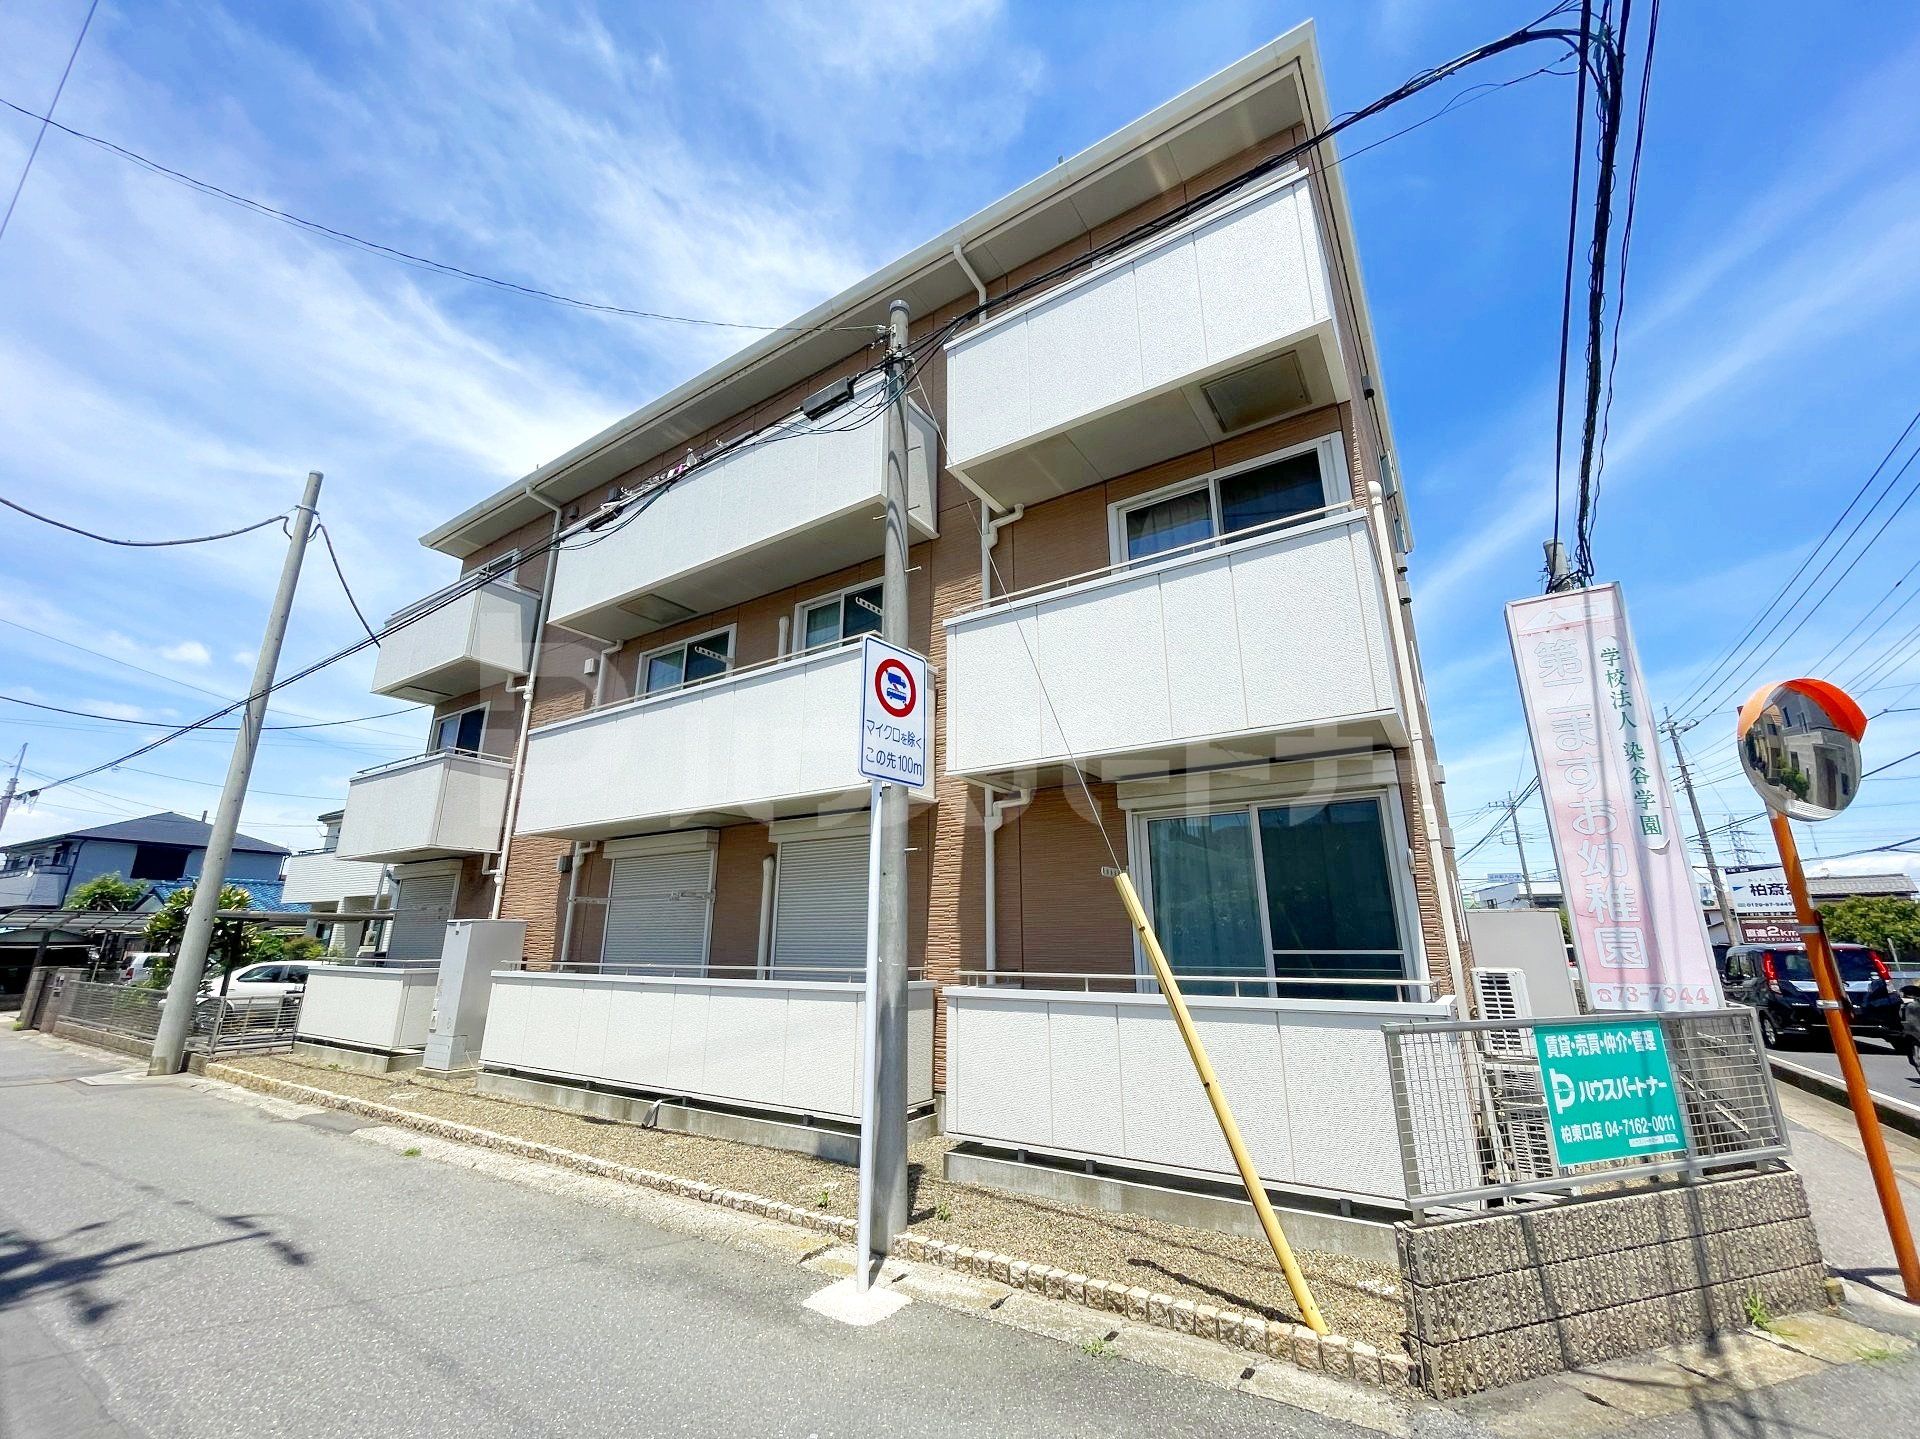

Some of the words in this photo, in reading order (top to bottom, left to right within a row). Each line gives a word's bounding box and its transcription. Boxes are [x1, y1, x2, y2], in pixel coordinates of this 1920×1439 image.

[865, 719, 922, 750] マイクロを除く
[1599, 646, 1638, 731] 学校法人
[1623, 741, 1663, 837] 染谷学園
[1578, 1075, 1667, 1103] ハウスパートナー
[1560, 1121, 1604, 1144] 柏東口店
[1604, 1114, 1676, 1138] 04-7162-0011
